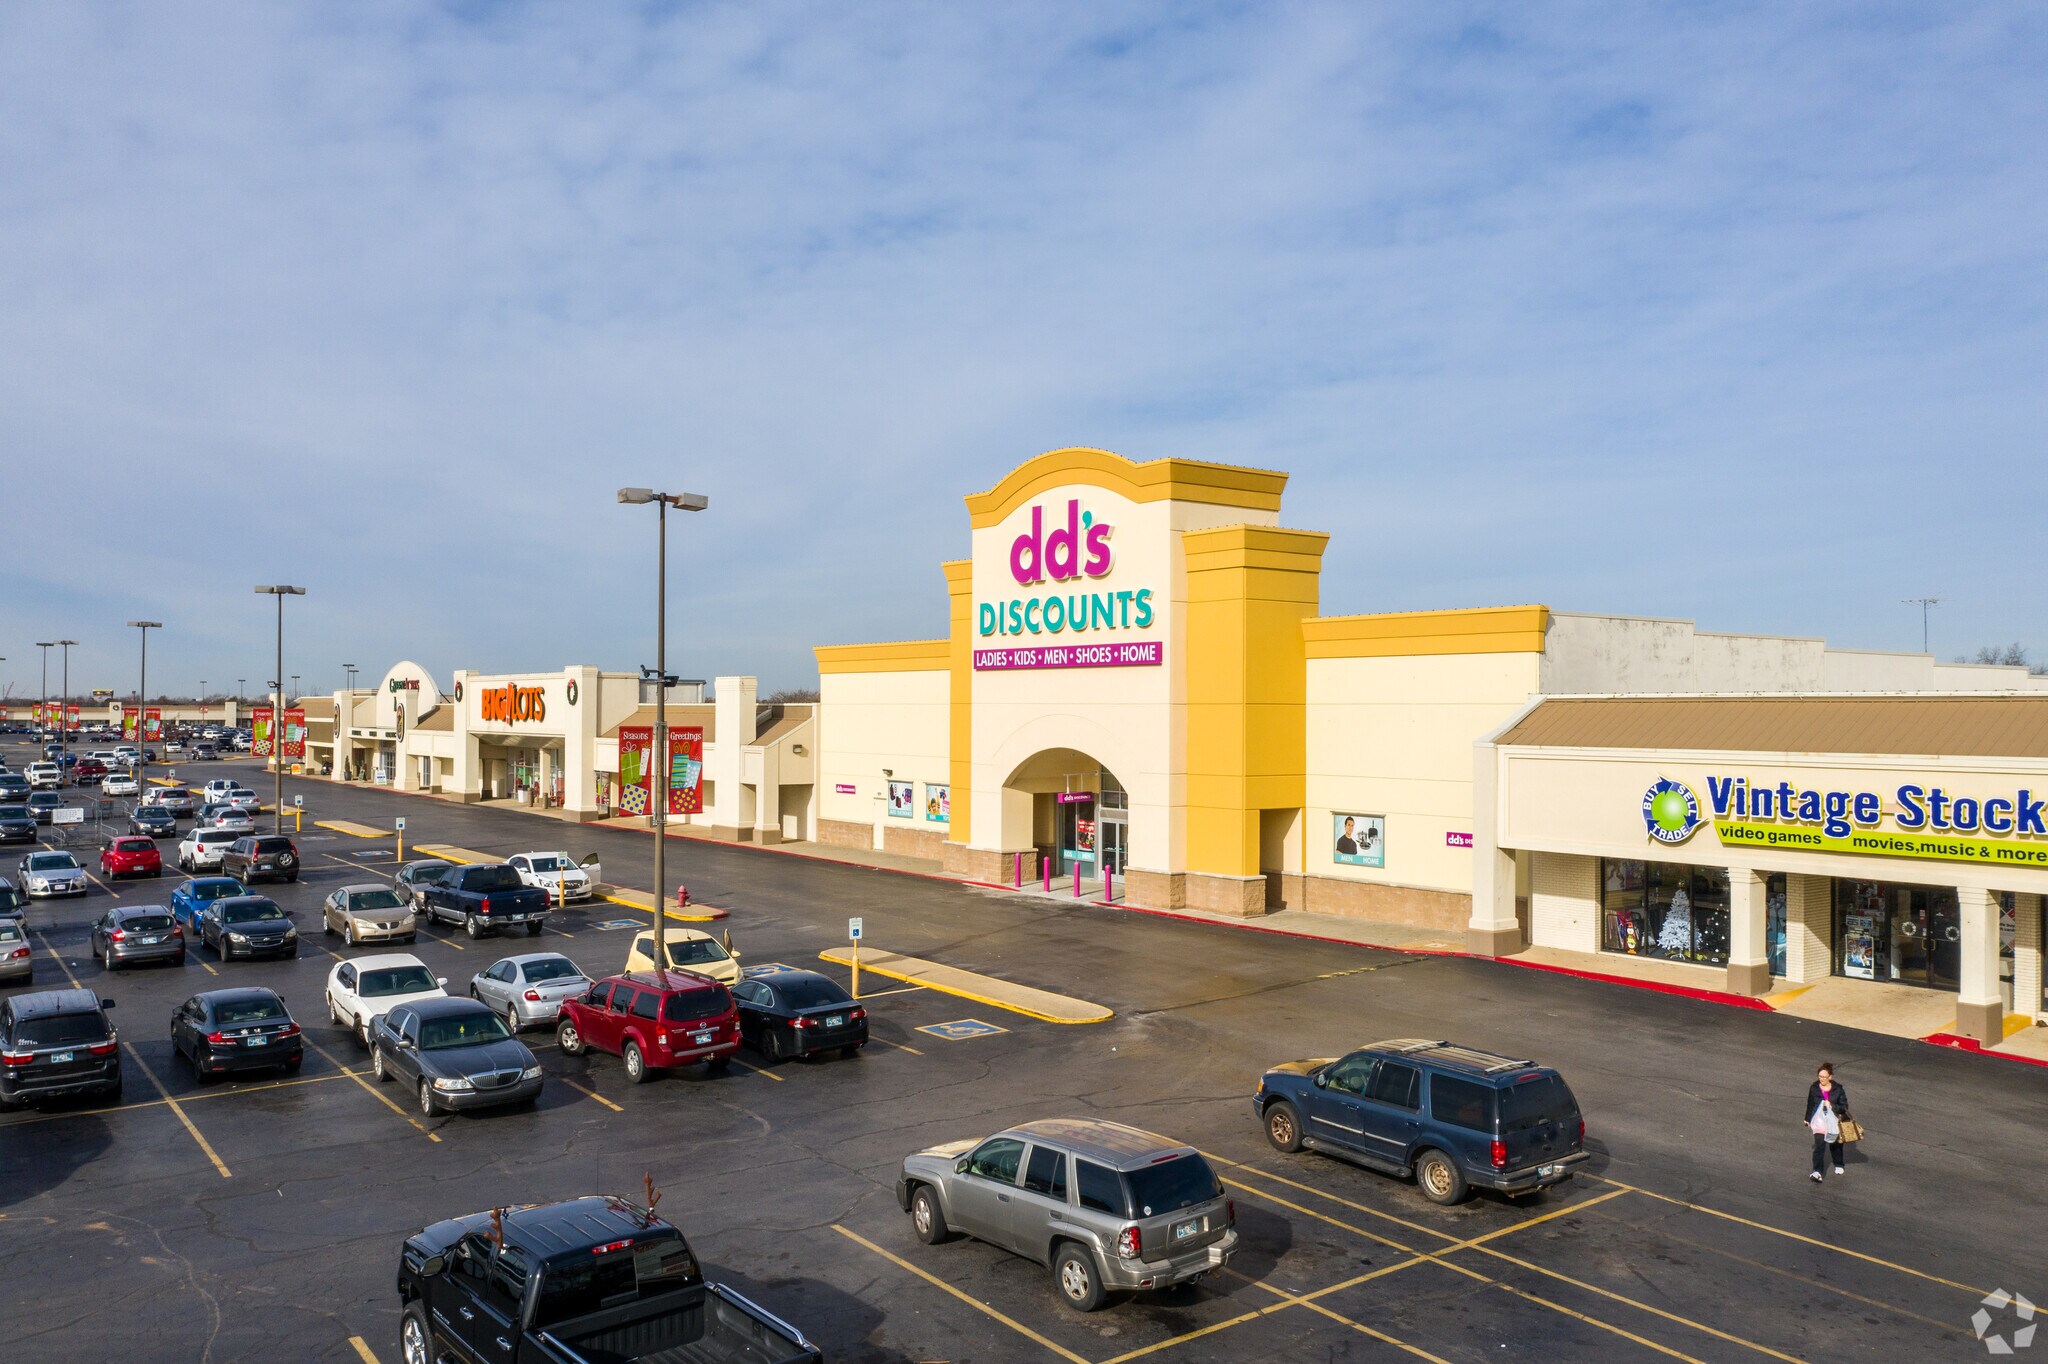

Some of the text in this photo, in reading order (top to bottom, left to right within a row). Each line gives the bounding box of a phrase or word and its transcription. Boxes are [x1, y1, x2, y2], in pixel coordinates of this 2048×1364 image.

[1010, 499, 1114, 584] dd's
[980, 589, 1152, 635] DISCOUNTS
[976, 645, 1156, 667] LADIES KIDS MEN SHOES HOME
[623, 731, 649, 740] Seasons
[670, 732, 702, 741] Greetings
[1643, 785, 1659, 810] BUY
[1678, 785, 1697, 816] SELL
[1706, 775, 2048, 838] Vintage Stock
[1448, 834, 1464, 845] dd's
[1653, 823, 1689, 840] TRADE
[1720, 825, 1764, 840] video
[1768, 831, 1822, 845] games
[1979, 846, 1990, 858] &
[1996, 848, 2048, 862] more
[1341, 854, 1379, 865] MEN HOME
